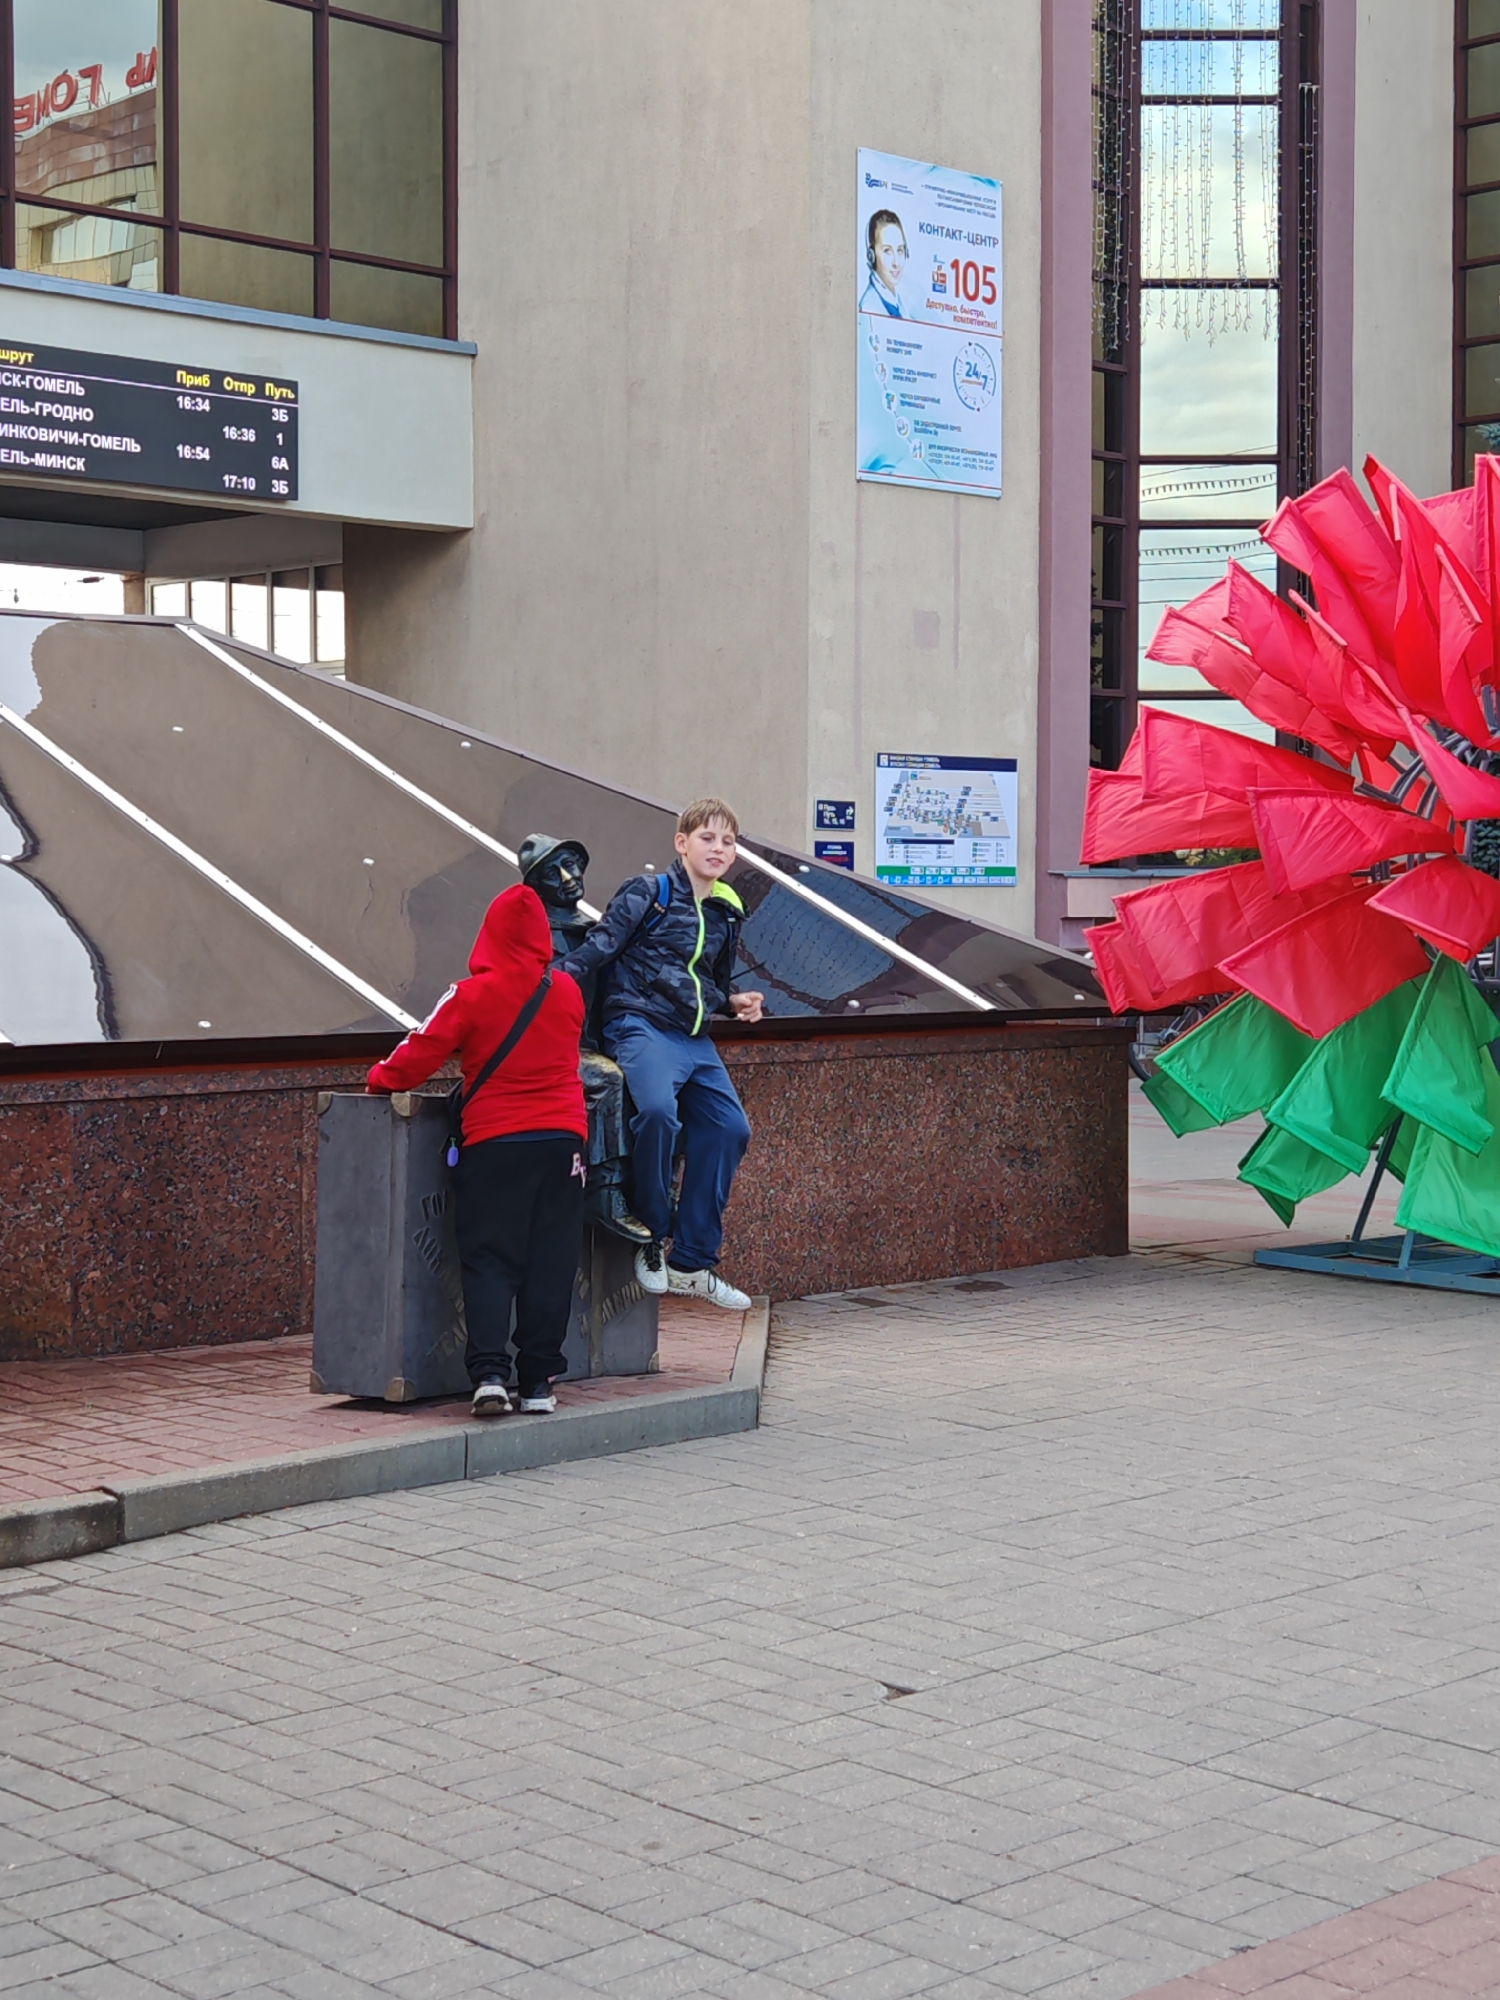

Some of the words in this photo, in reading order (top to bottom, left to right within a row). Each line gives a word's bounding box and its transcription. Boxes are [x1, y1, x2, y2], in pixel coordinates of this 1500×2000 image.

[918, 221, 999, 249] КОНТАКТ-ЦЕНТР
[950, 258, 997, 305] 105
[176, 369, 211, 388] Приб
[223, 376, 256, 396] Отпр
[265, 382, 296, 399] Путь
[176, 395, 211, 413] 16:34
[271, 408, 289, 422] 3Б
[222, 425, 256, 443] 16:36
[276, 432, 284, 446] 1
[176, 444, 211, 461] 16:54
[271, 456, 289, 471] 6А
[222, 474, 256, 491] 17:10
[271, 479, 289, 494] 3Б
